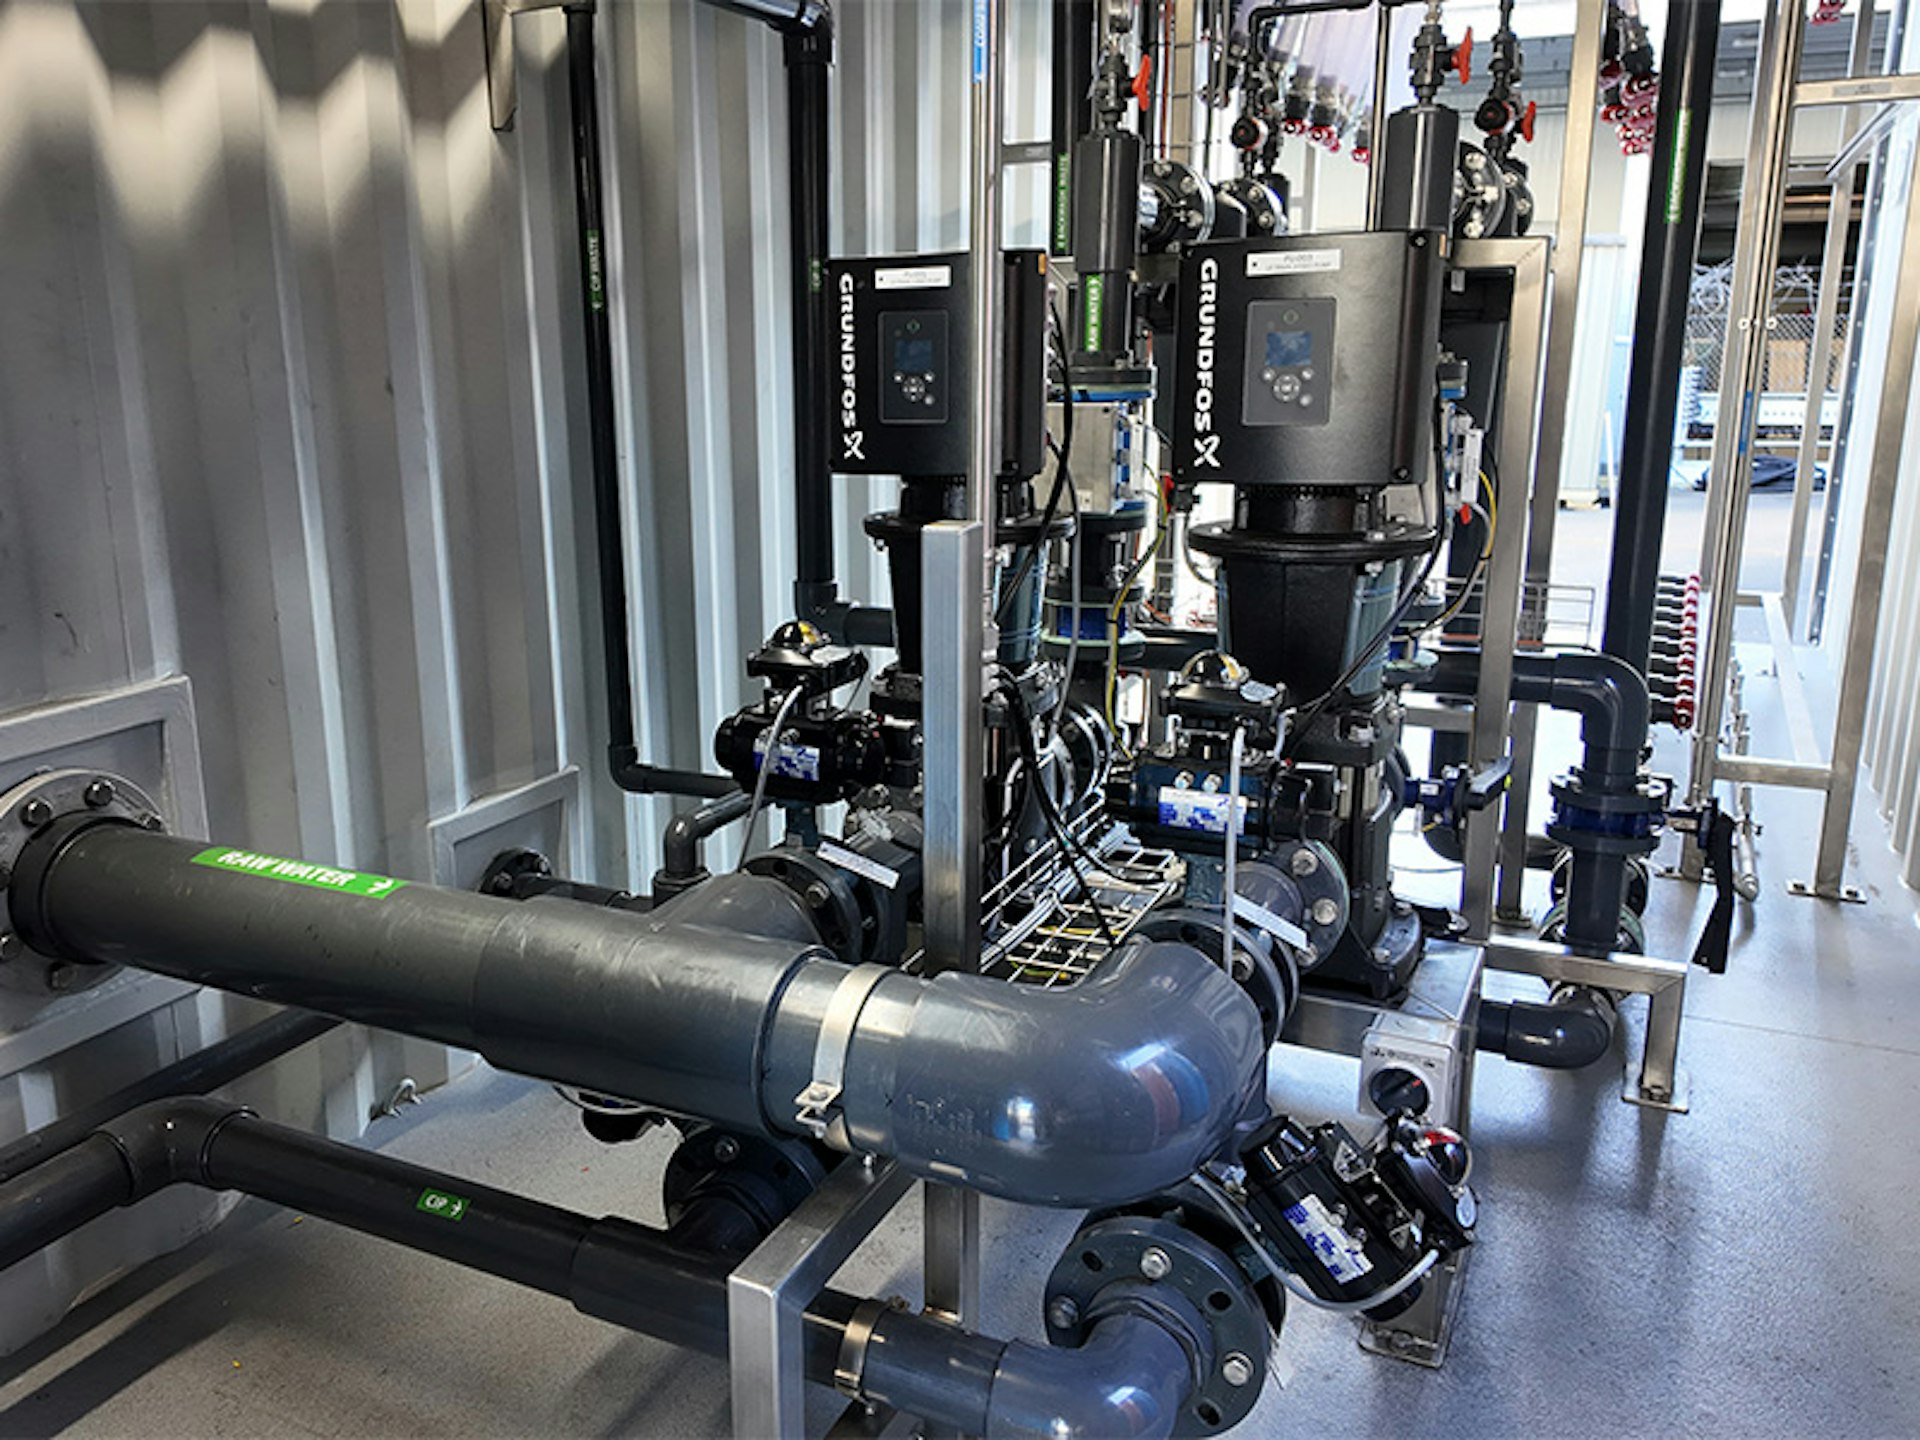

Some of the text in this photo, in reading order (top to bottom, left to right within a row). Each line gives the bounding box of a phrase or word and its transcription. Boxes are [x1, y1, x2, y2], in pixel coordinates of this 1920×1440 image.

[839, 272, 856, 428] GRUNDFOS
[1088, 287, 1101, 324] WATER
[1194, 258, 1218, 432] GRUNDFOS
[217, 850, 357, 887] RAW WATER
